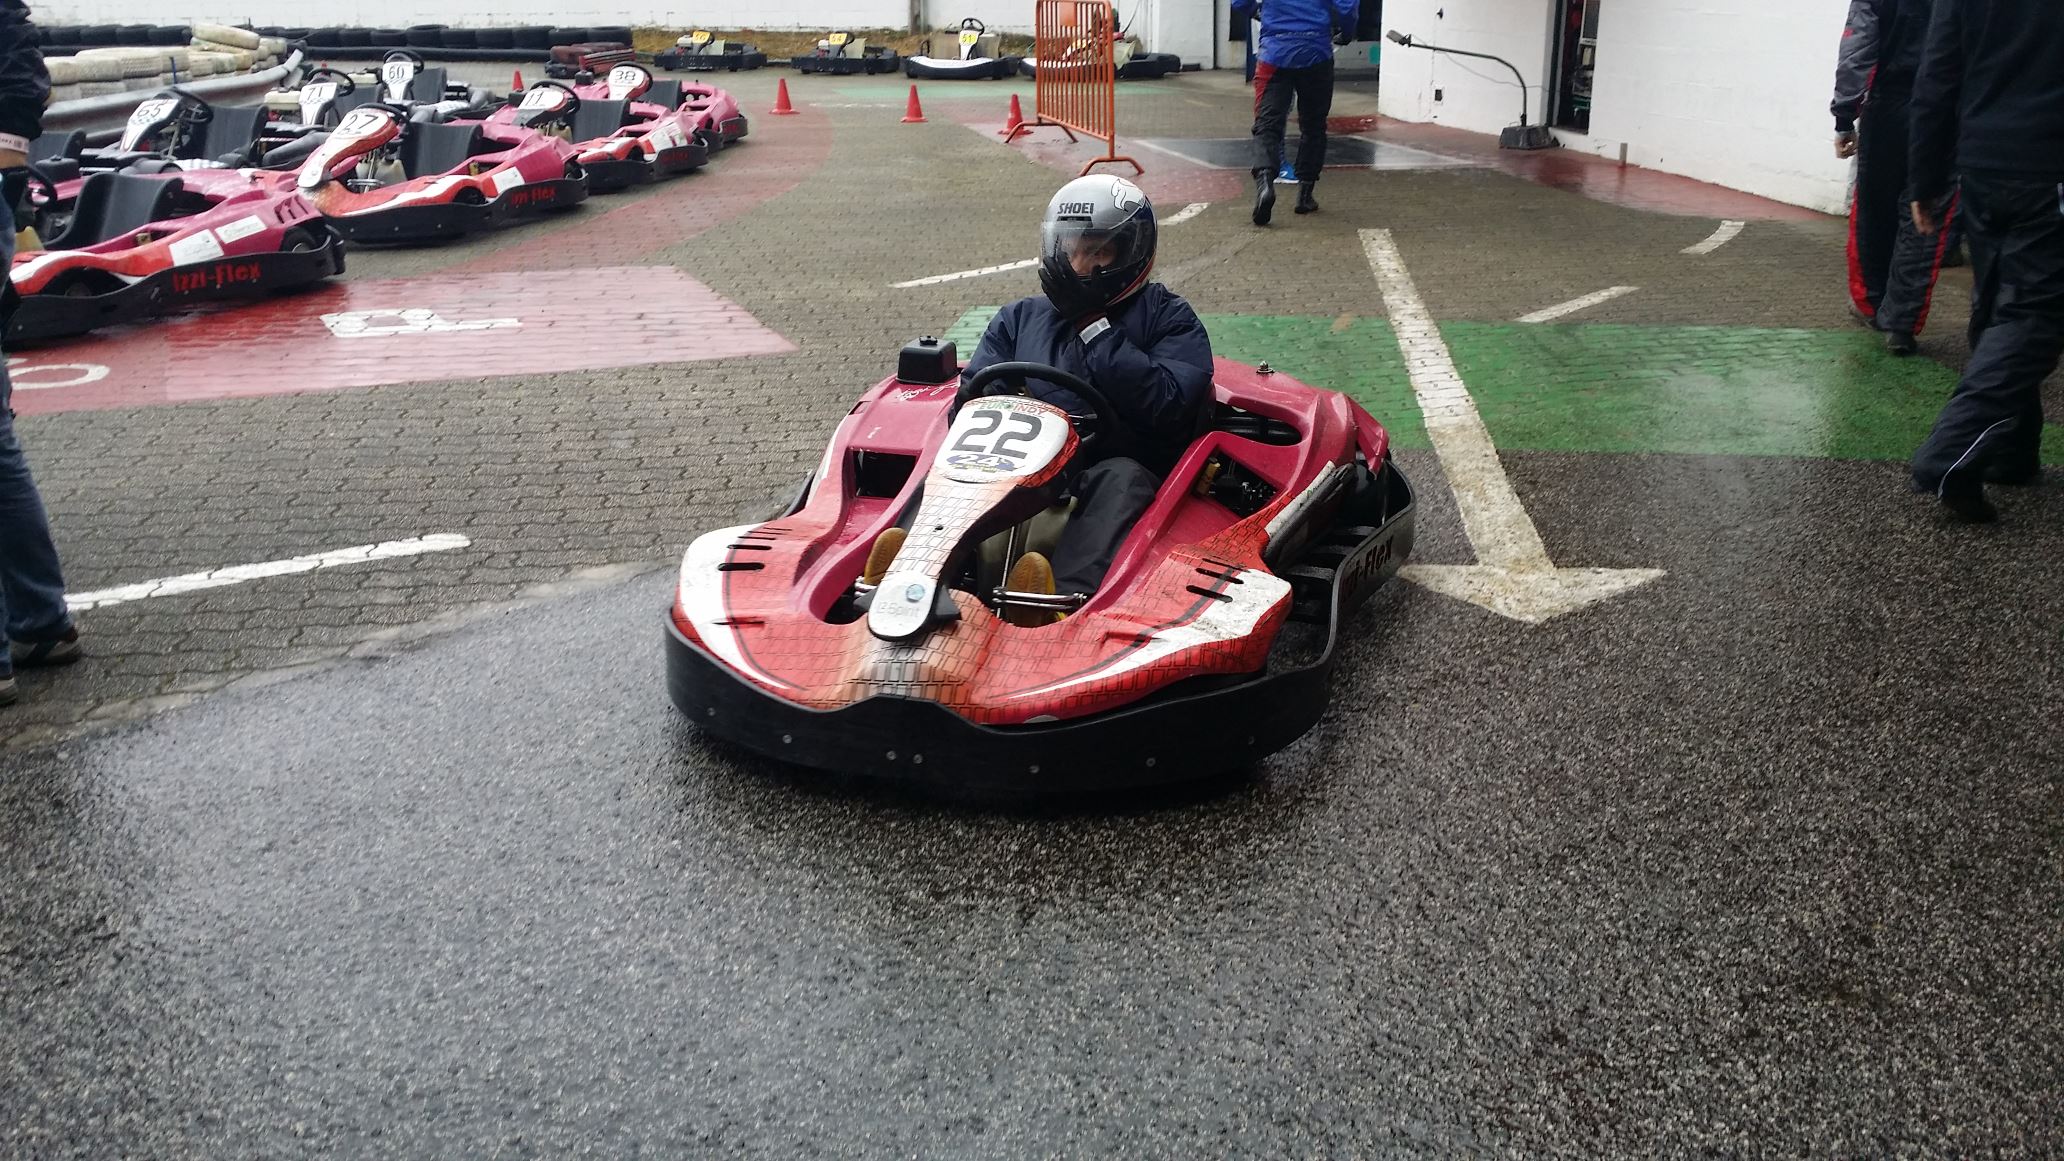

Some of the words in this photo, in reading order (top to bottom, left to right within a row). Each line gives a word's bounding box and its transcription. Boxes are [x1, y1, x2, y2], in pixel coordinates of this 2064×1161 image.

[388, 65, 405, 80] 60
[615, 70, 637, 81] 38
[342, 113, 379, 131] 27
[1057, 202, 1094, 214] SHOEI
[950, 410, 1042, 460] 22
